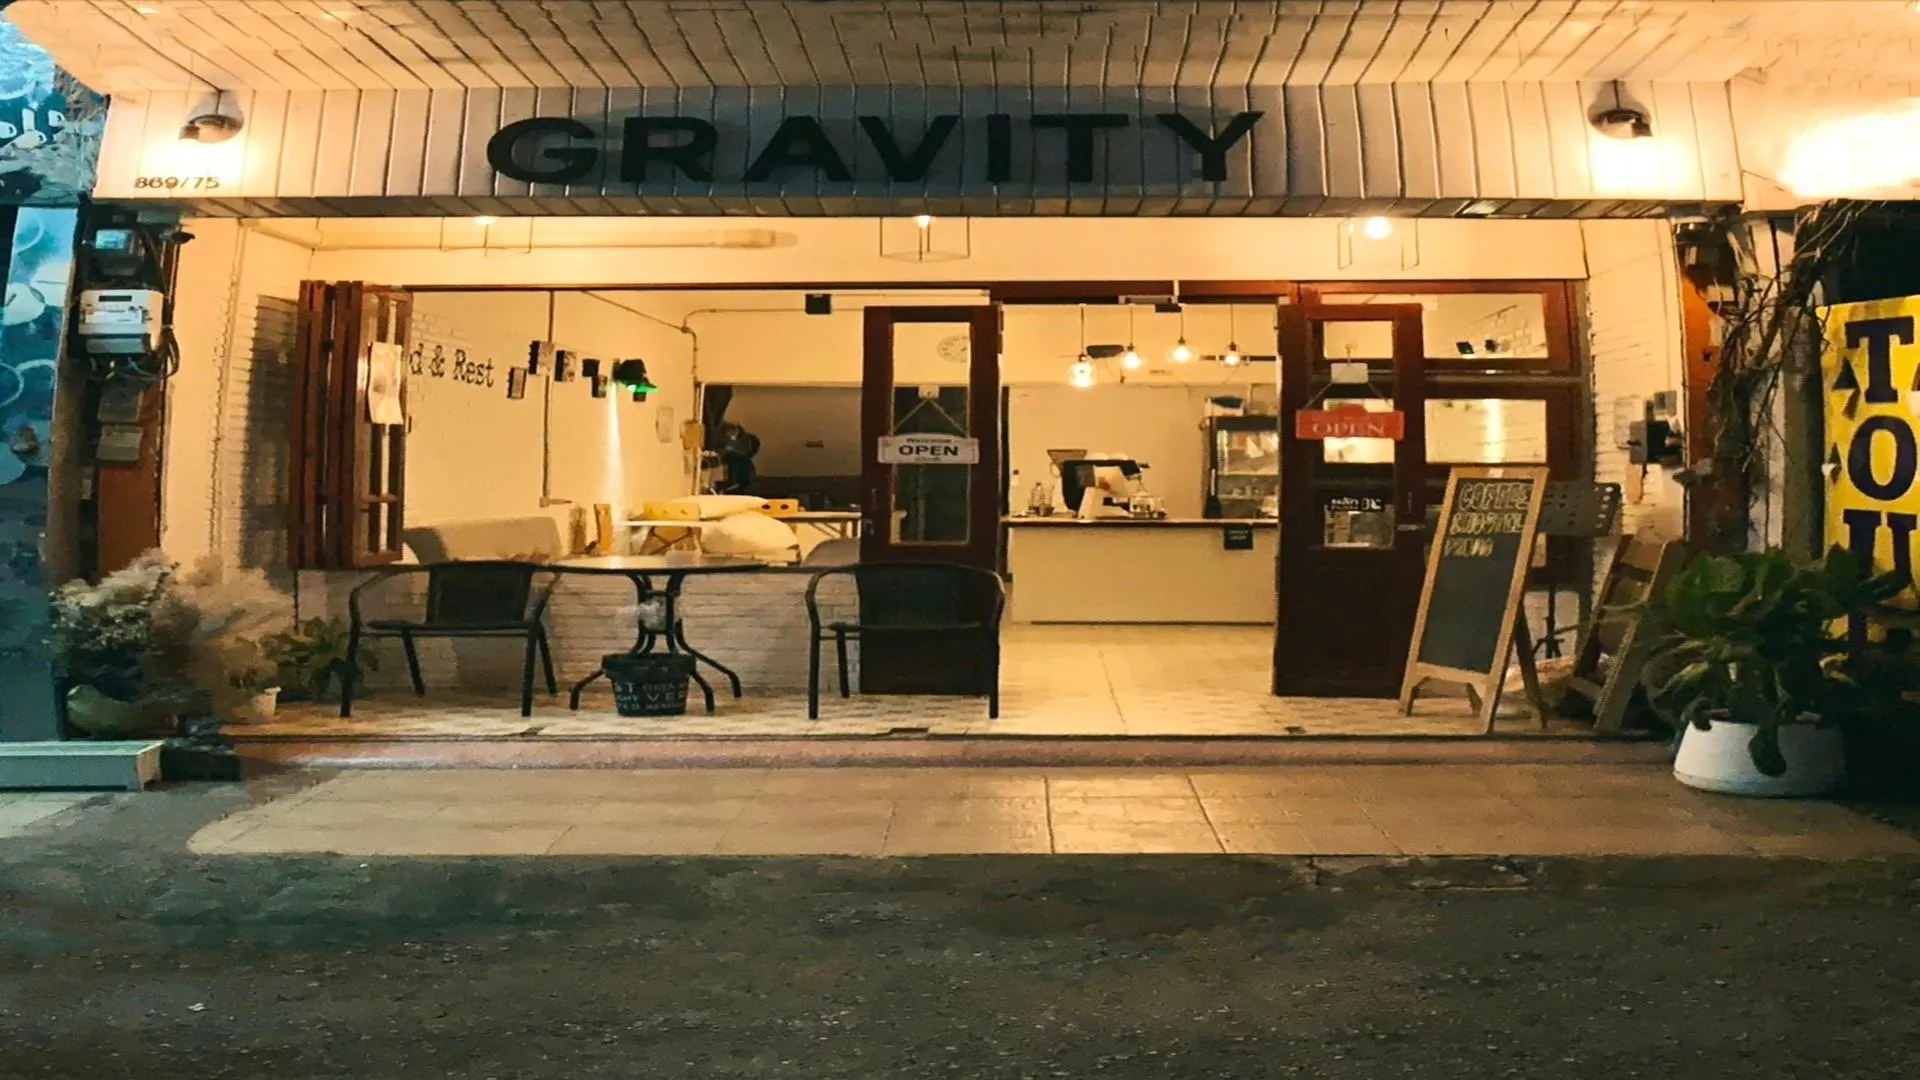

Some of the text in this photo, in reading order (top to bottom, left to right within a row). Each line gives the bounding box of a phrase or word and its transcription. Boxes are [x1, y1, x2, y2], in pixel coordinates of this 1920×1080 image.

[487, 111, 1263, 184] GRAVITY
[134, 177, 220, 189] 869/75
[428, 345, 445, 376] &
[452, 349, 494, 388] Rest
[1311, 422, 1386, 436] OPEN
[898, 445, 958, 456] OPEN
[1844, 318, 1919, 643] TOU
